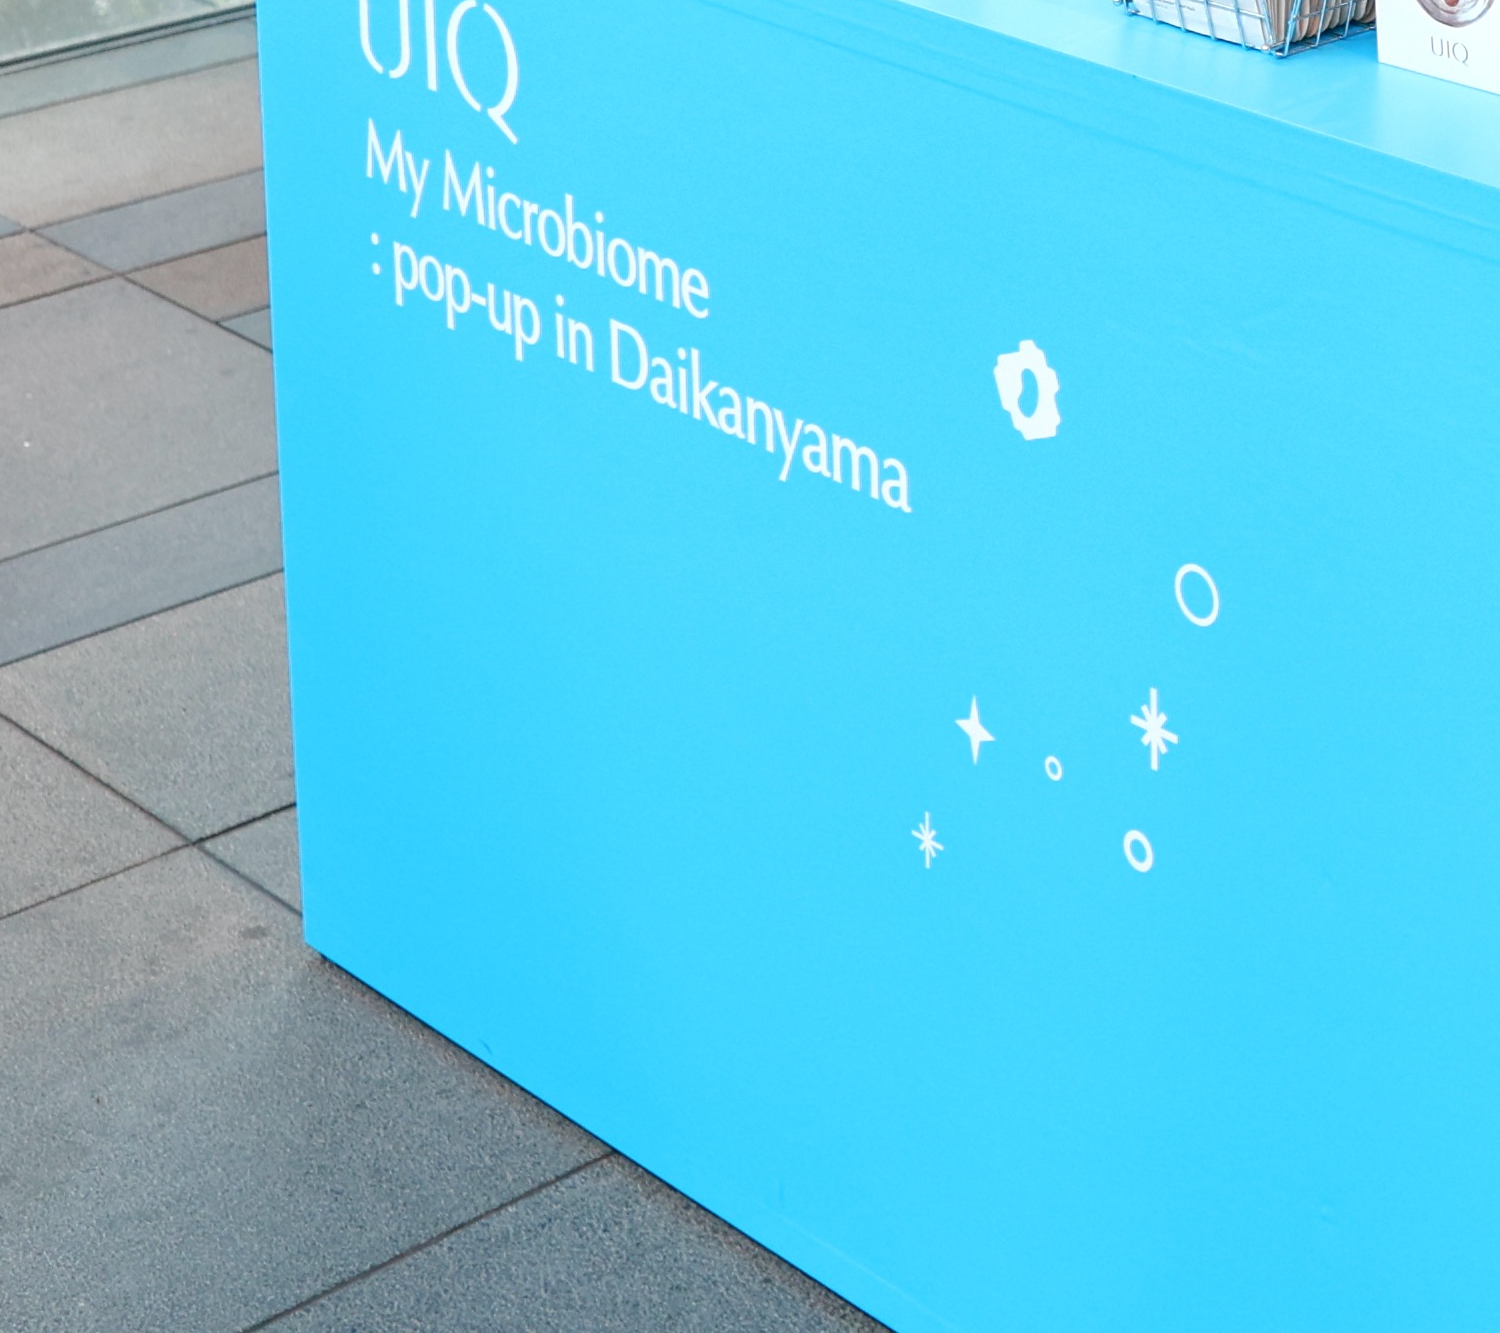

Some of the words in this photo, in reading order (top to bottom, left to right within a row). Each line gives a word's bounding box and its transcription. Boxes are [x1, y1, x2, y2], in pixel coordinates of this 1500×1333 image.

[1430, 35, 1469, 67] UIQ
[364, 118, 430, 219] My
[441, 149, 711, 320] Microbiome
[392, 236, 541, 362] pop-up
[554, 294, 595, 375] in
[609, 322, 913, 514] Daikanyama
